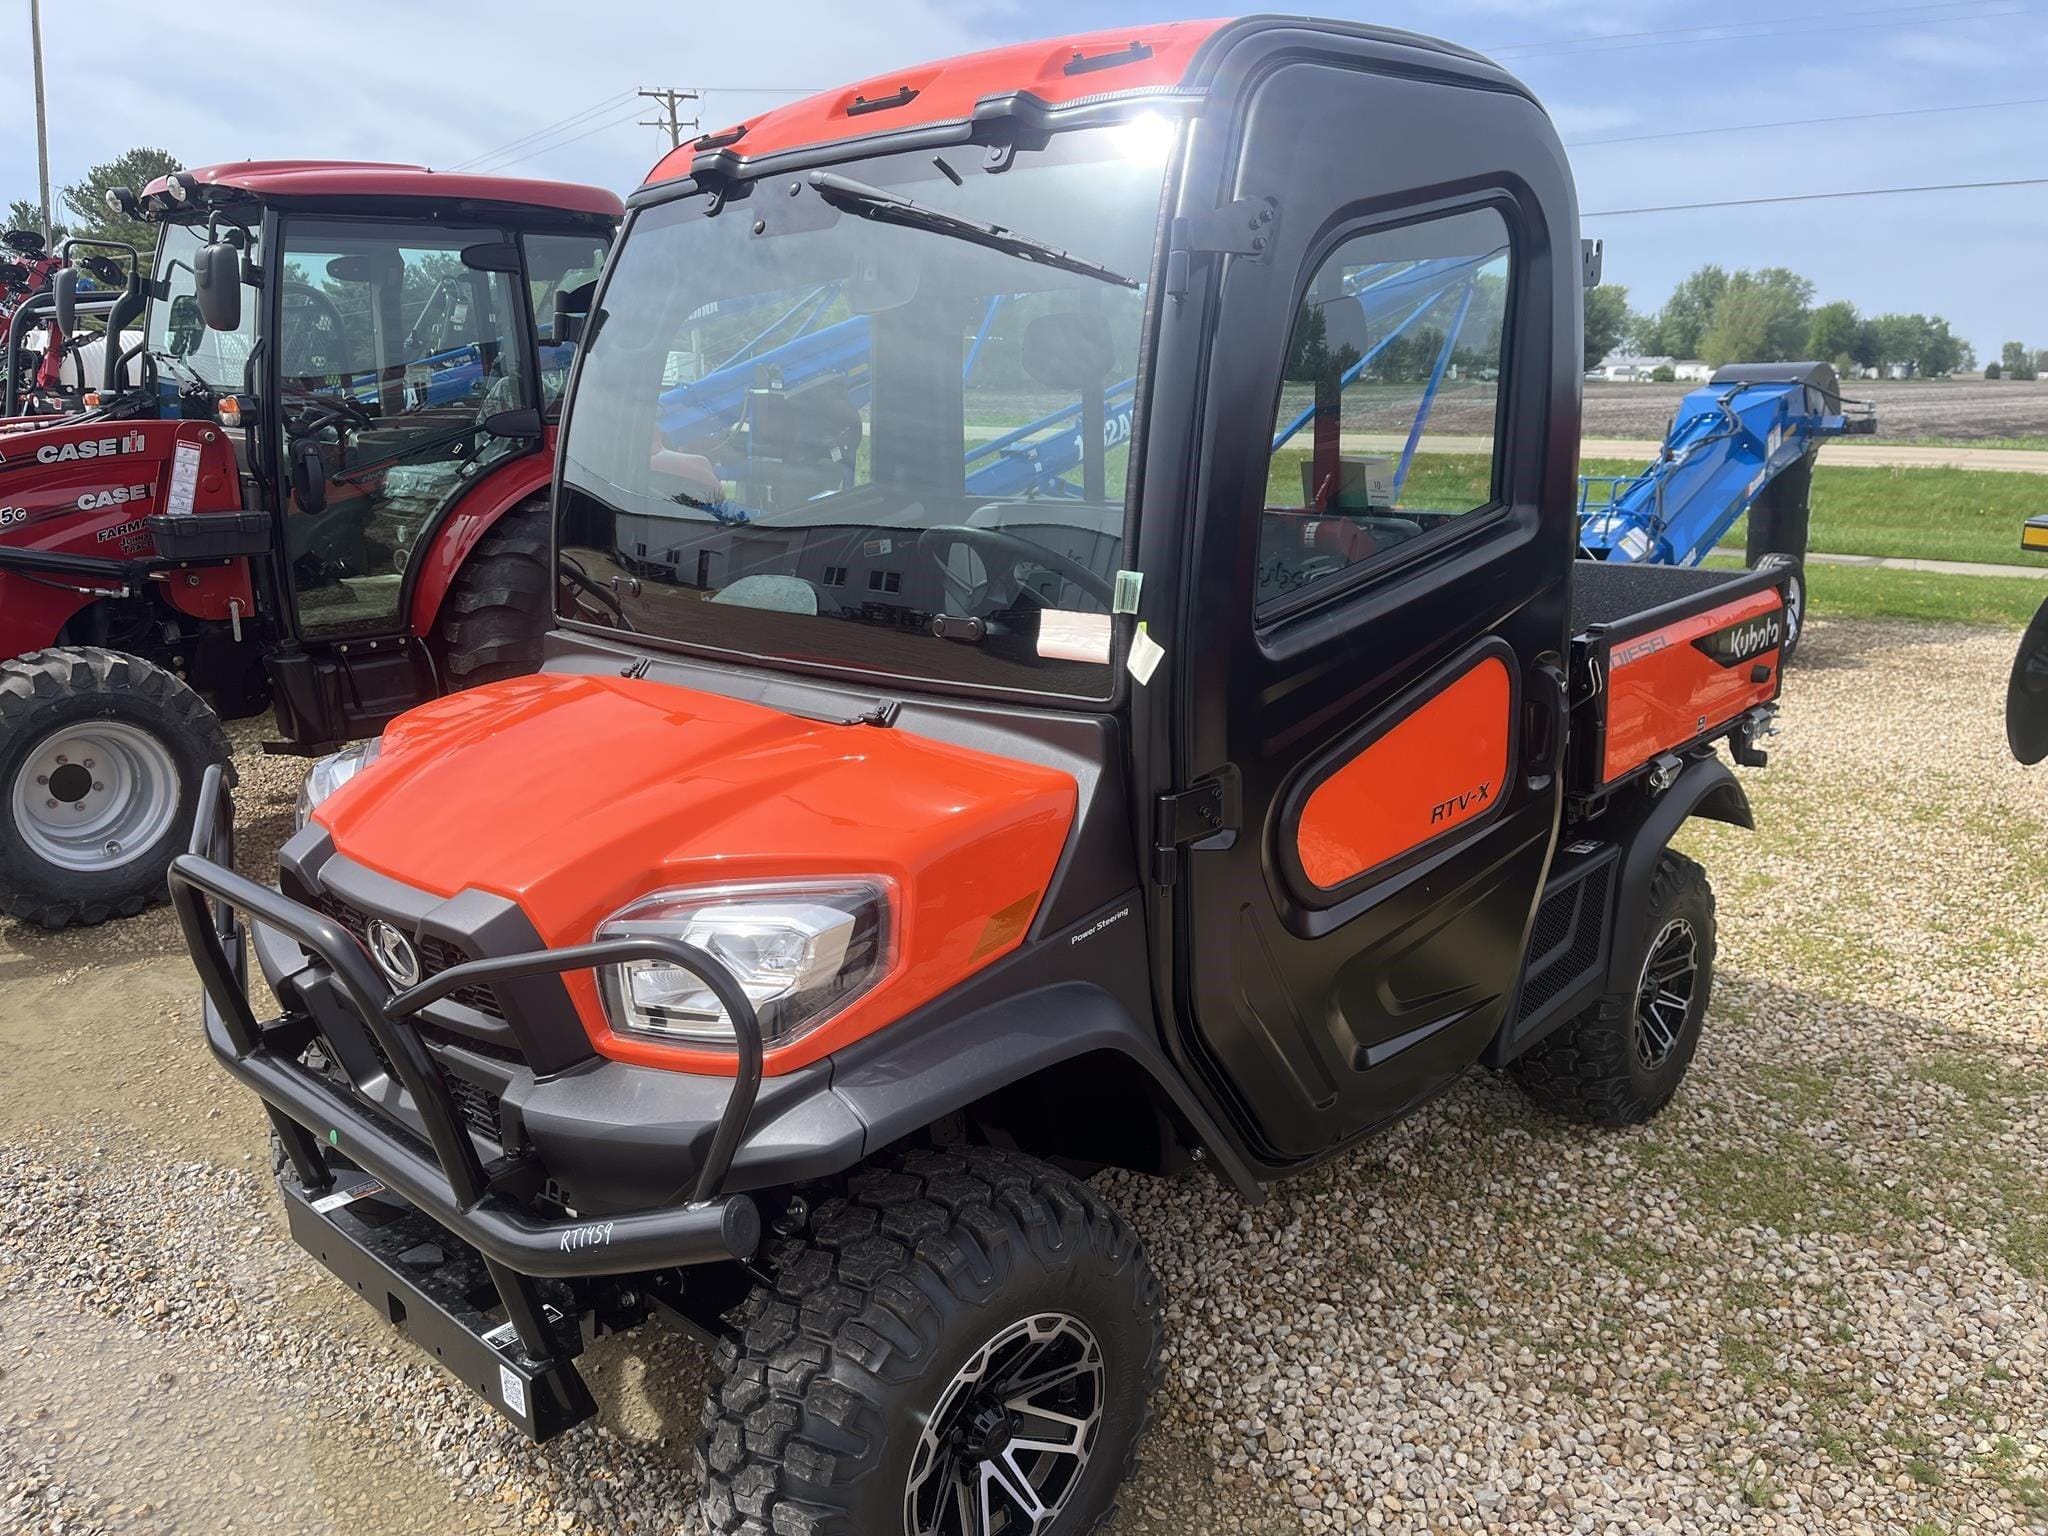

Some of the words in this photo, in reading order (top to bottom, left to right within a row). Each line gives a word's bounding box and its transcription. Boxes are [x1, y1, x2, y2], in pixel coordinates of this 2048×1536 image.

[37, 438, 117, 464] CASE
[77, 483, 146, 510] CASE
[1611, 635, 1675, 669] DIESEL
[1730, 617, 1779, 658] Kubota
[1431, 781, 1490, 824] RTV-X
[1071, 925, 1097, 945] Power
[1096, 907, 1129, 931] Steering
